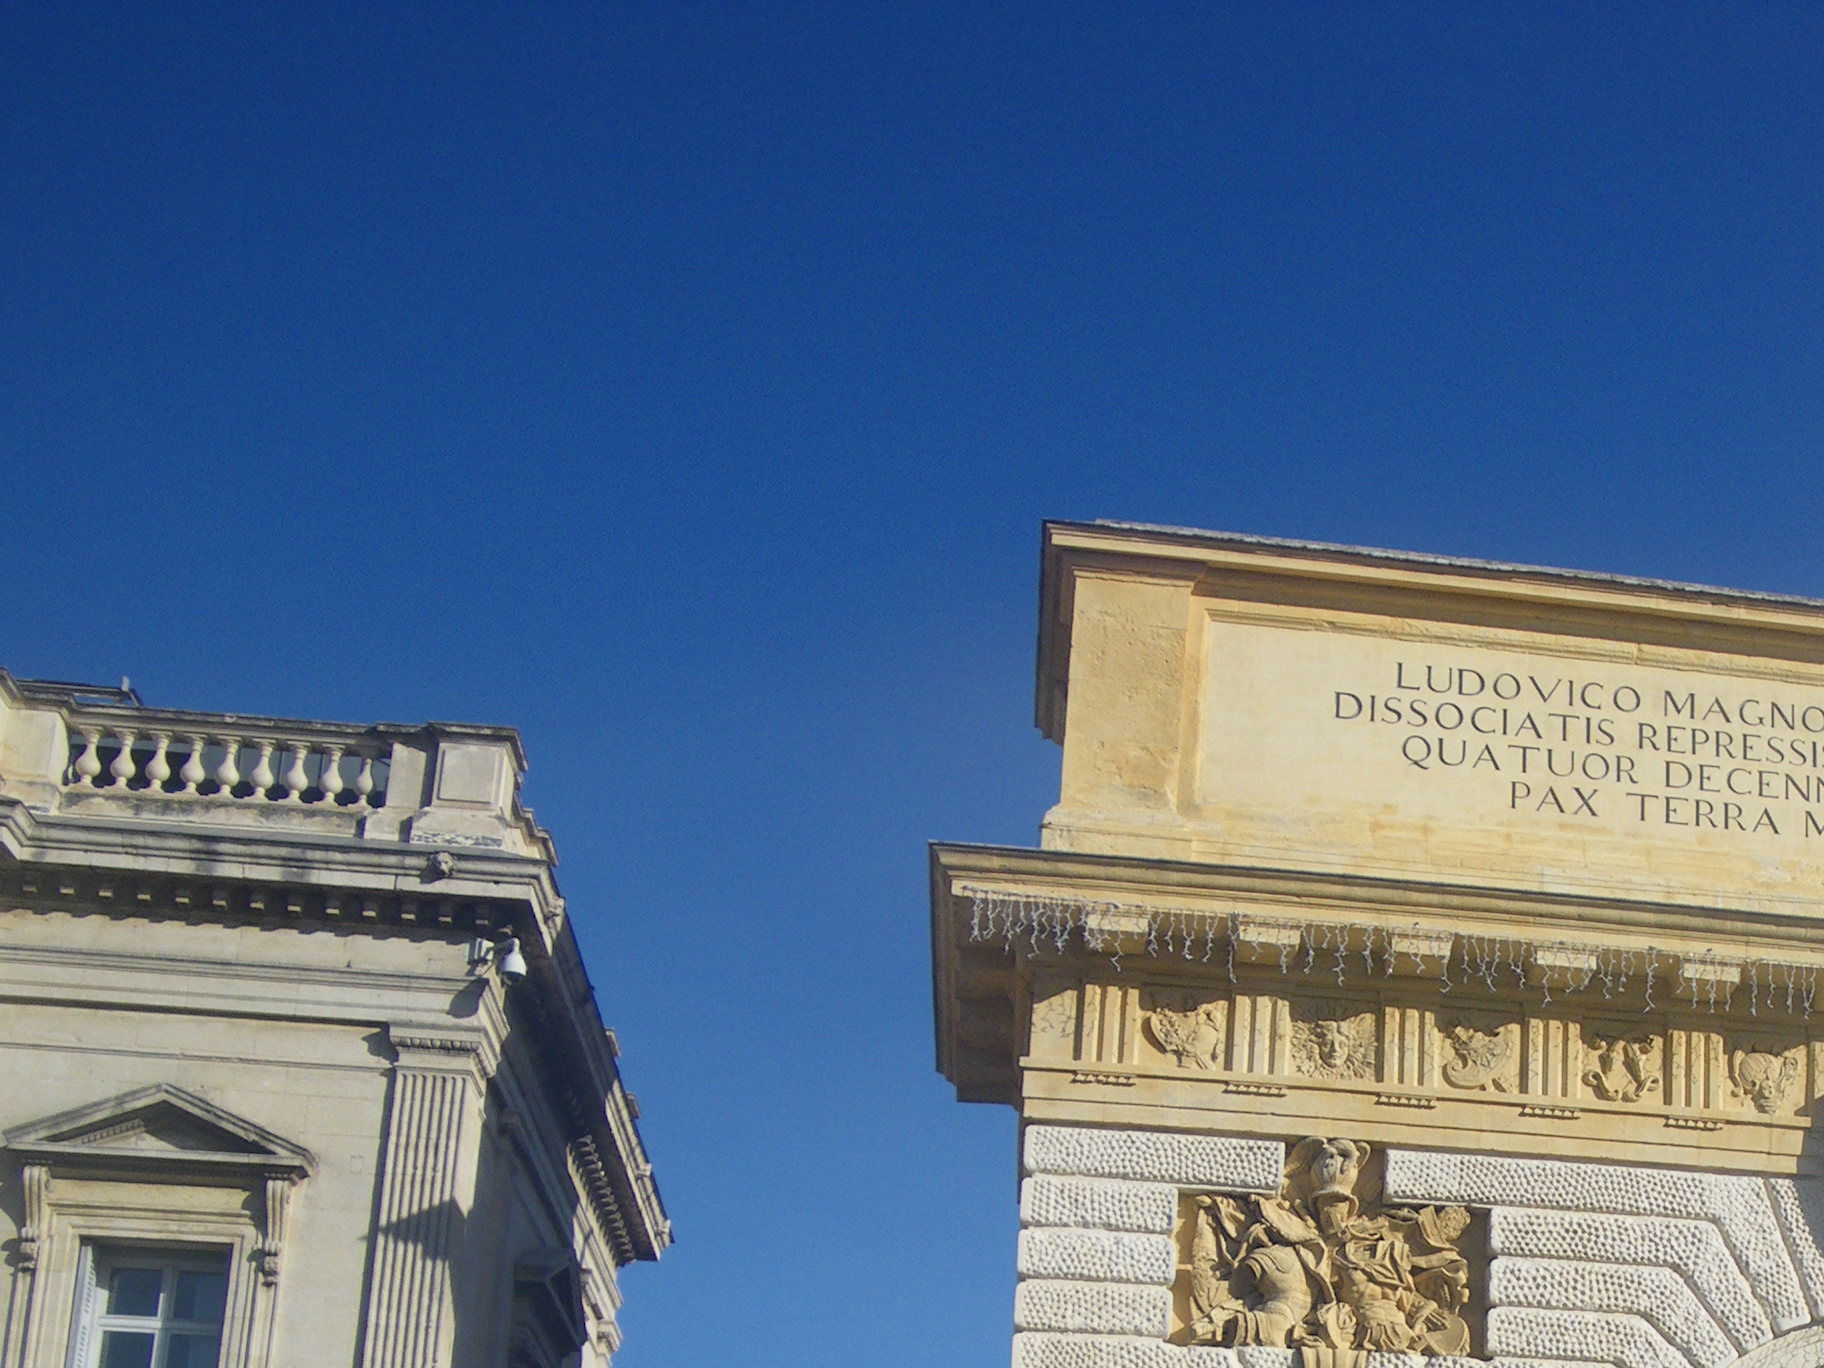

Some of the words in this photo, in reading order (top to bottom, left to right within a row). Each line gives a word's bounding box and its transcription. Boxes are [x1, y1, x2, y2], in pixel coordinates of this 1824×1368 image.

[1397, 662, 1641, 712] LUDOVICO
[1335, 691, 1614, 745] DISSOCIATIS
[1402, 735, 1638, 784] QUATUOR
[1511, 781, 1598, 817] PAX
[1626, 793, 1780, 835] TERRA
